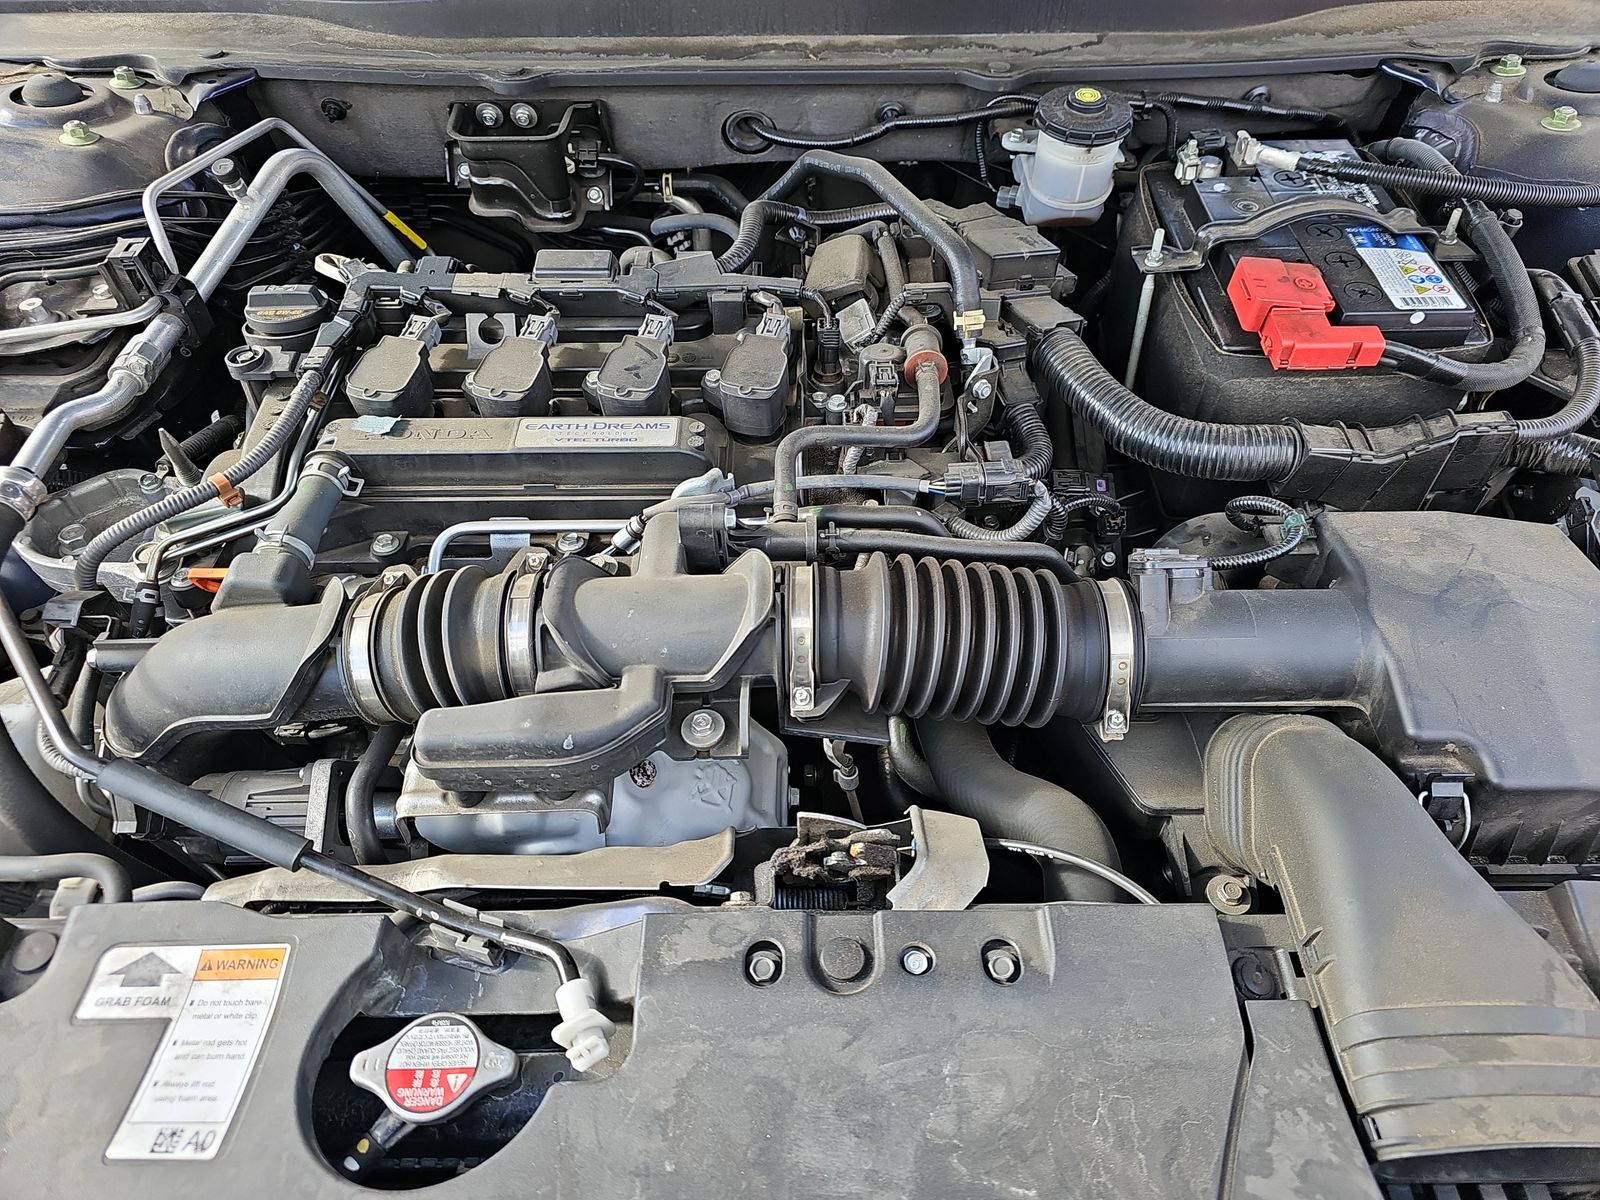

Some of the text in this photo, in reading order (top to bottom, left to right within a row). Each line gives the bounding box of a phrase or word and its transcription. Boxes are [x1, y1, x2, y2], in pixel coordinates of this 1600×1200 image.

[525, 422, 589, 431] EARTH
[215, 958, 279, 971] WARNING
[94, 996, 172, 1007] GRAB FOAM
[192, 1012, 213, 1020] metal
[223, 1012, 244, 1020] white
[217, 1039, 233, 1048] gets
[396, 1087, 445, 1098] WARNUNG
[403, 1096, 444, 1107] DANGER
